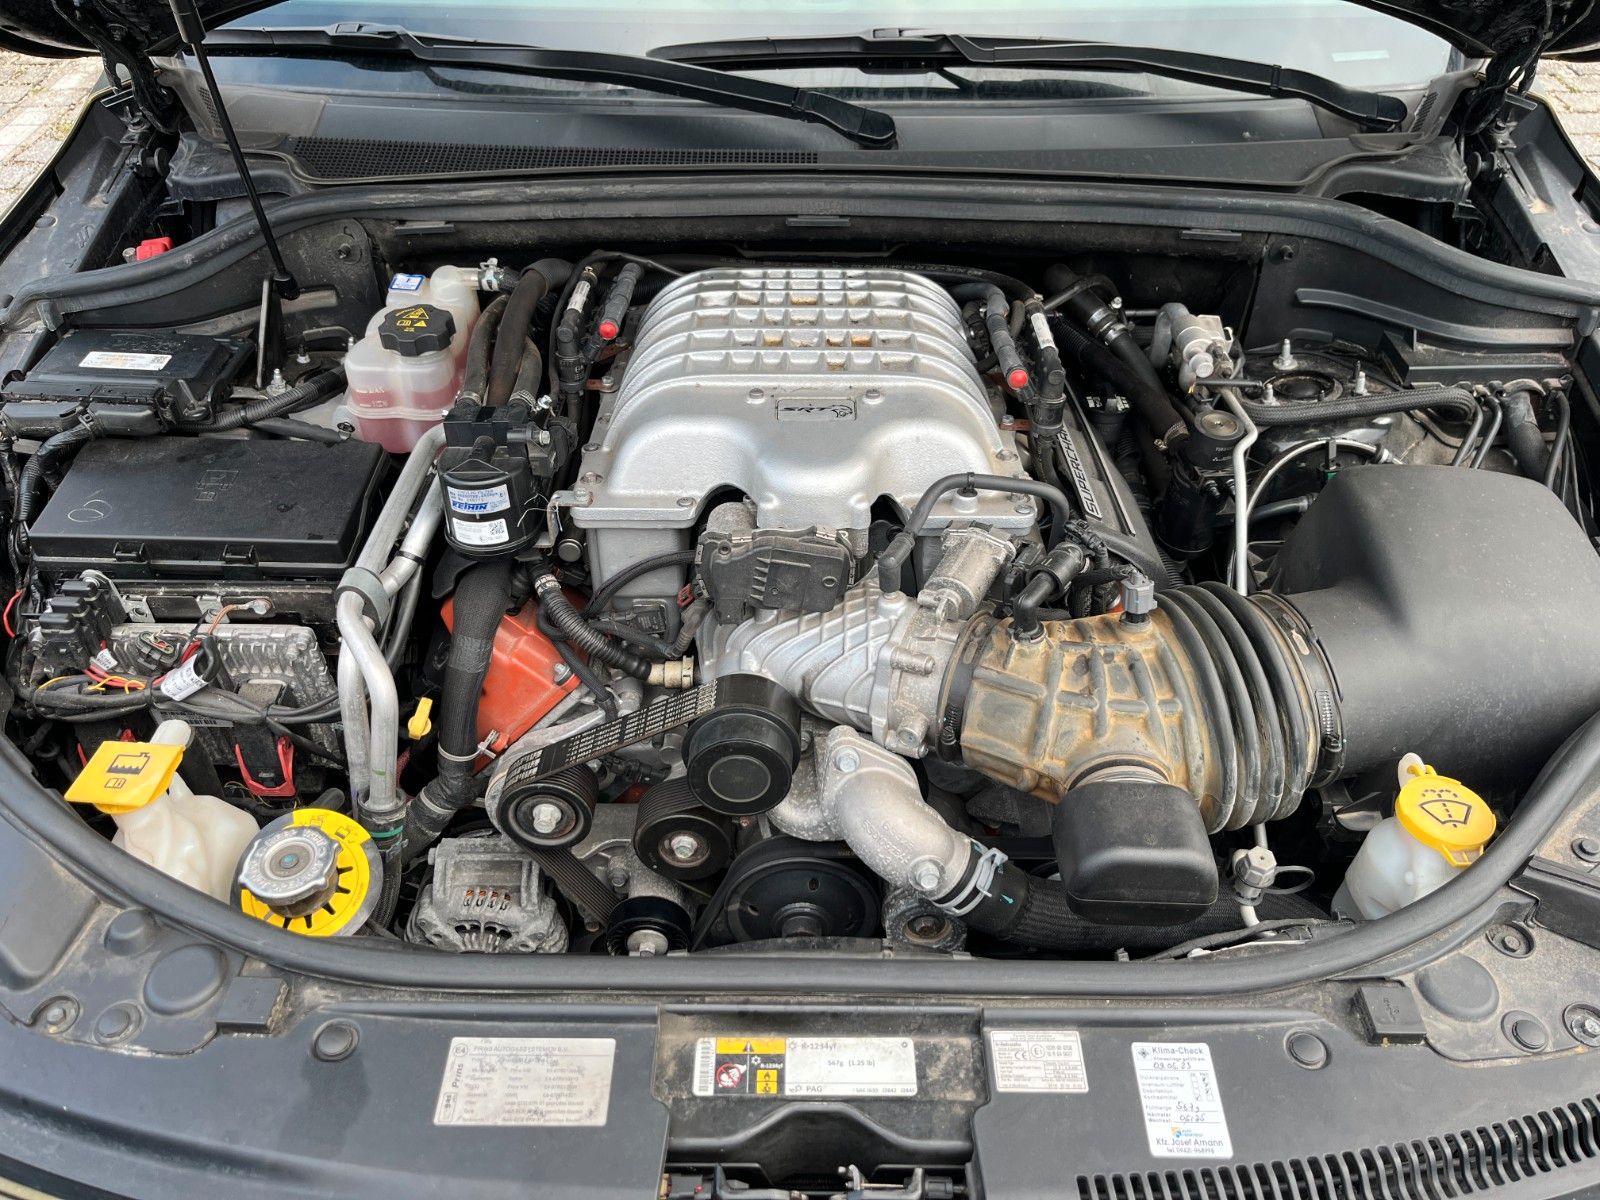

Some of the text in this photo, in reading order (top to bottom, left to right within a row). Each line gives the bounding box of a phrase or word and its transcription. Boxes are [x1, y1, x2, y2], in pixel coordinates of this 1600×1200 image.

[452, 501, 489, 511] KEIHIN
[801, 1042, 837, 1051] R-1234yf
[1152, 1047, 1204, 1055] Klima-Check
[452, 1063, 464, 1088] Prins
[806, 1085, 823, 1093] PAG
[1171, 1138, 1192, 1146] Josef
[1193, 1138, 1224, 1147] Amann
